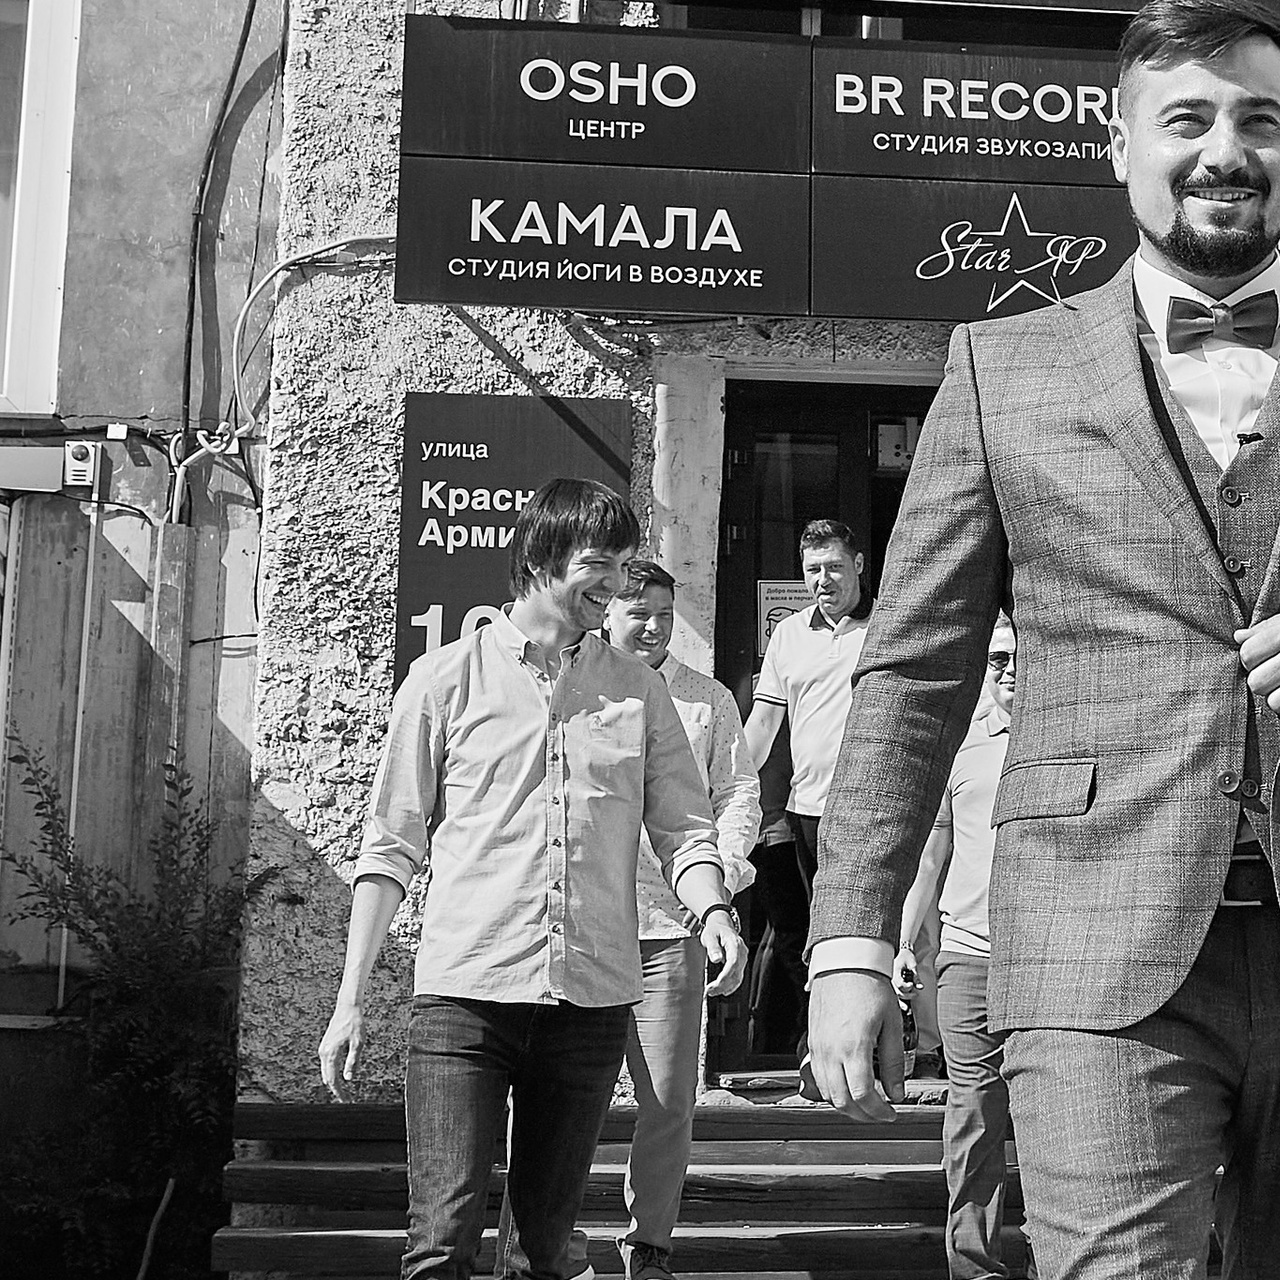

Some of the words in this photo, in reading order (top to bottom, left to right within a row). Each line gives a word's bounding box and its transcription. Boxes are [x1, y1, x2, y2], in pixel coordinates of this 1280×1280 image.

[520, 59, 696, 107] OSHO
[836, 74, 904, 115] BR
[569, 119, 645, 139] ЦЕНТР
[874, 134, 968, 155] СТУДИЯ
[471, 199, 742, 252] КАМАЛА
[916, 221, 1011, 279] Star
[449, 259, 549, 280] СТУДИЯ
[557, 259, 621, 281] ЙОГИ
[630, 265, 642, 282] В
[651, 266, 762, 288] ВОЗДУХЕ
[422, 443, 488, 460] улица
